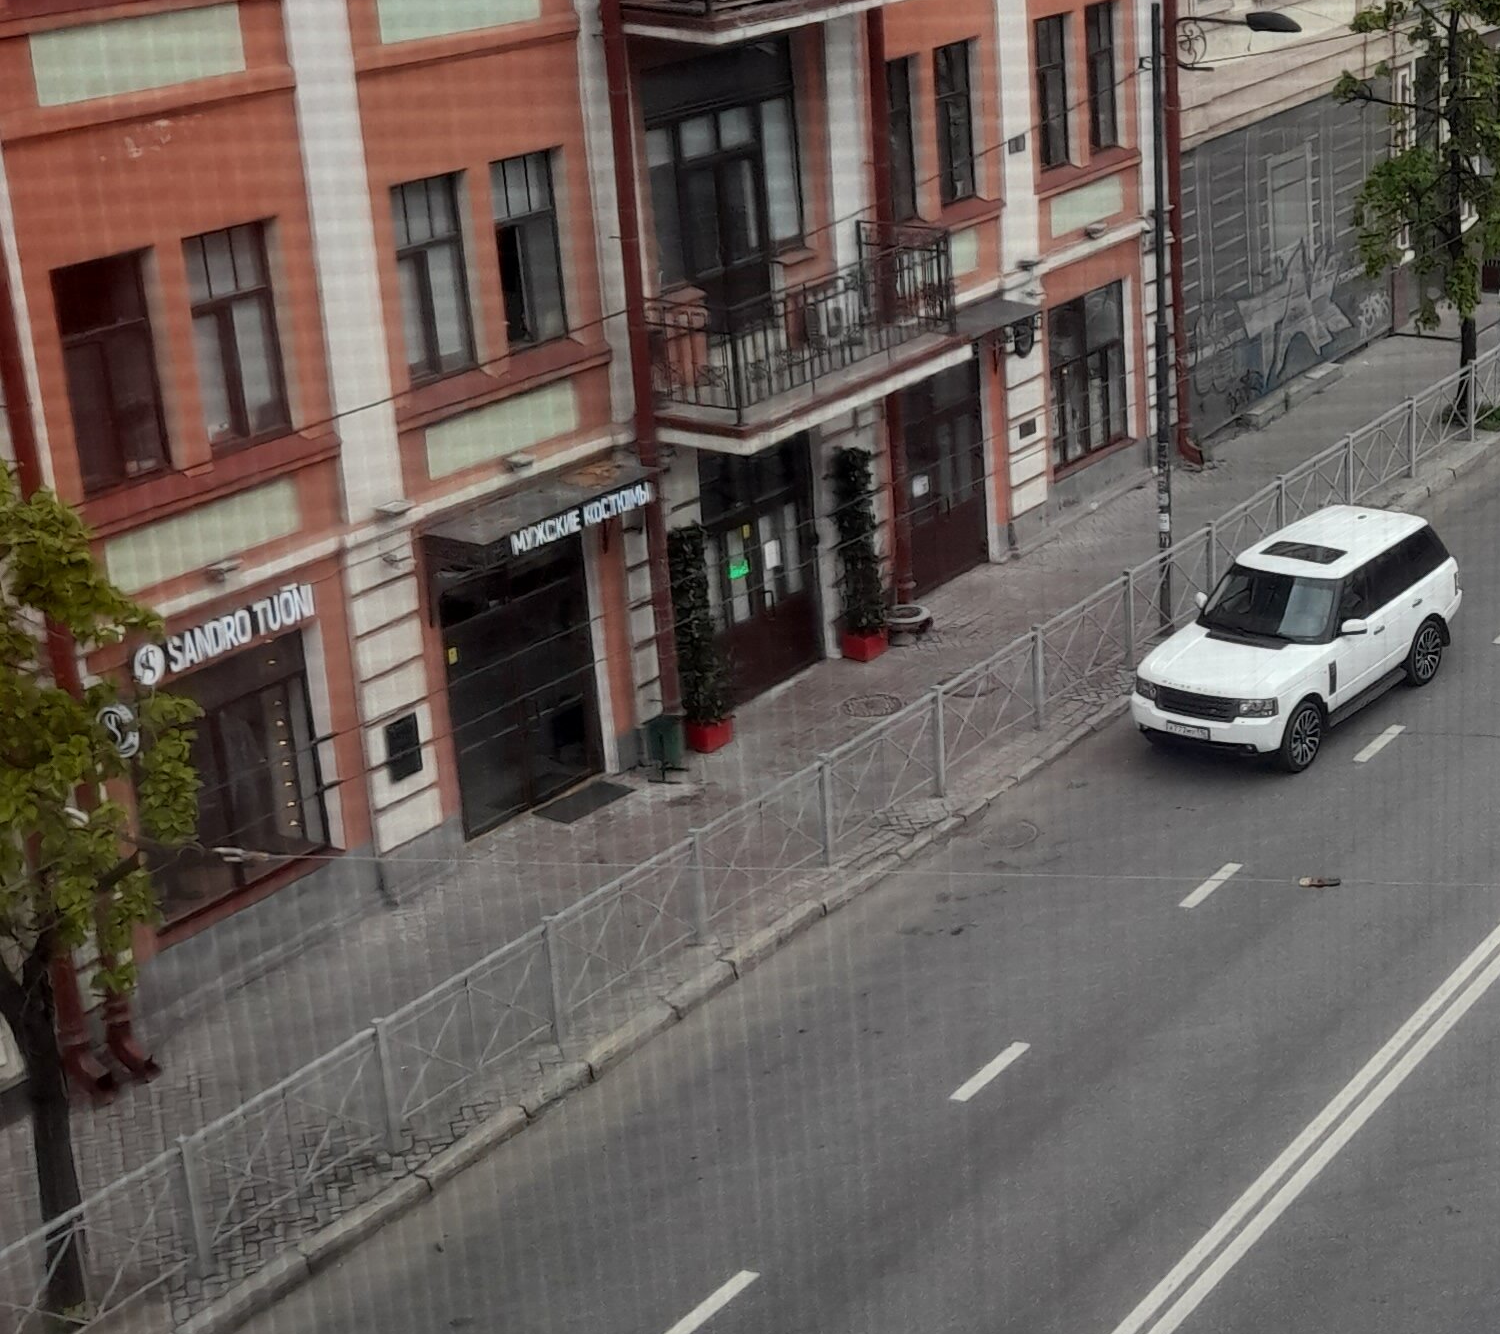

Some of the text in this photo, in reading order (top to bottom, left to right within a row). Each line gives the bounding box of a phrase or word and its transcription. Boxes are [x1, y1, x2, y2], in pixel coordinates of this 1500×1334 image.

[510, 482, 653, 555] МУЖСКИЕ КОСТЮМЫ
[167, 609, 252, 673] SANDRO
